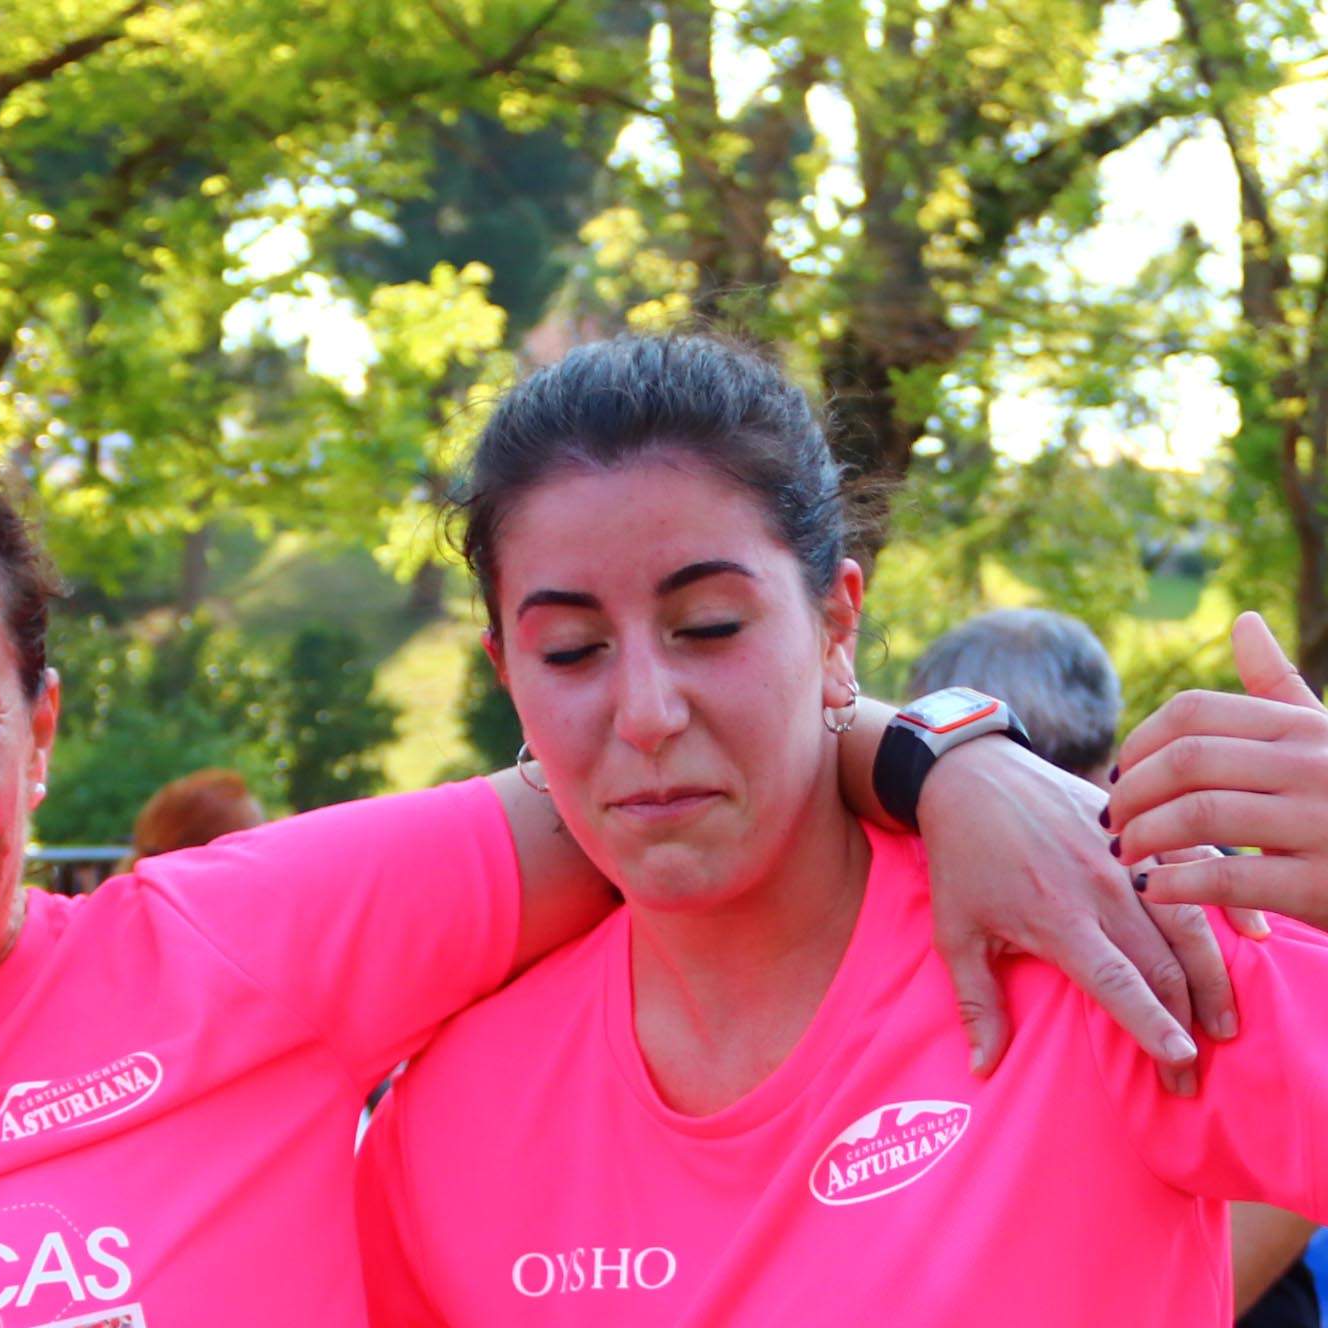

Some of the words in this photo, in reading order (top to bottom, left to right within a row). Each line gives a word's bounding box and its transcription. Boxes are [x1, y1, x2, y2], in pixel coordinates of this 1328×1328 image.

[1, 1066, 154, 1143] ASTURIANA
[845, 1133, 898, 1162] CENTRAL
[902, 1111, 961, 1140] LECHERA
[825, 1121, 961, 1198] ASTURIANA
[511, 1246, 677, 1297] OYSHO
